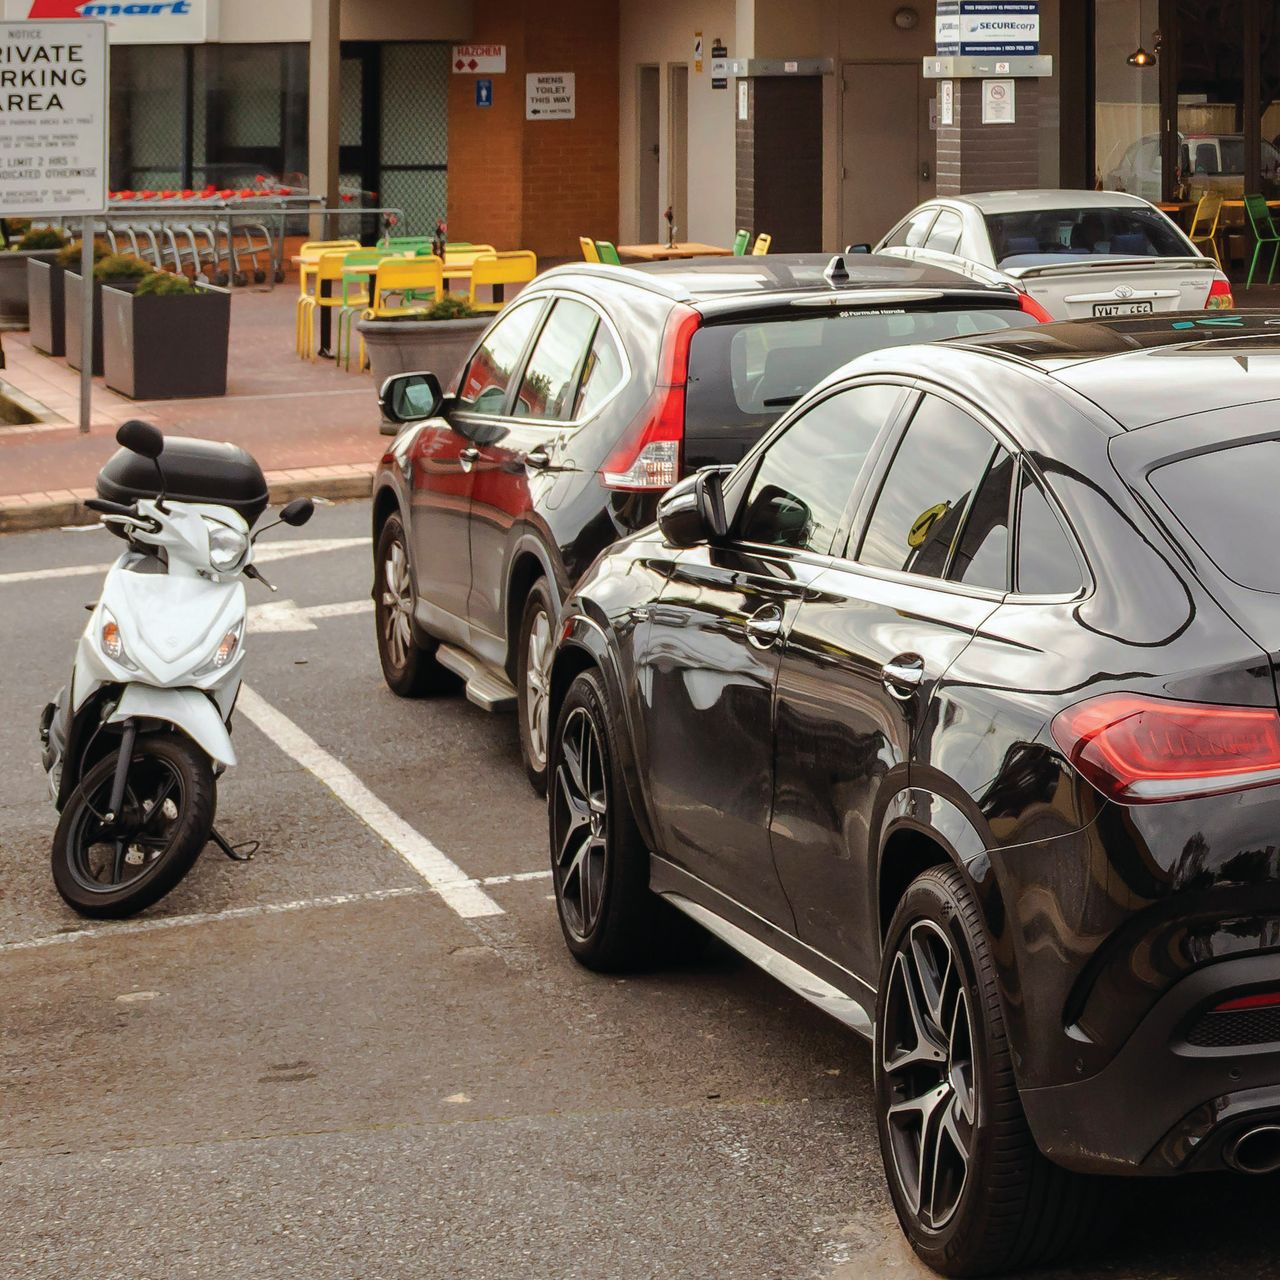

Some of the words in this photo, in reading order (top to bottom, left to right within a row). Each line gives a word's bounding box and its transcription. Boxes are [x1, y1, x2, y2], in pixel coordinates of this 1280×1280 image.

[979, 22, 1035, 31] SECUREcorp
[8, 30, 41, 39] NOTICE
[0, 45, 83, 62] IVATE
[458, 47, 501, 57] HAZCHEM
[536, 86, 566, 94] TOILET
[0, 94, 63, 111] REA
[38, 157, 44, 166] 2
[0, 169, 41, 180] DICATED
[45, 168, 96, 178] OTHERWISE
